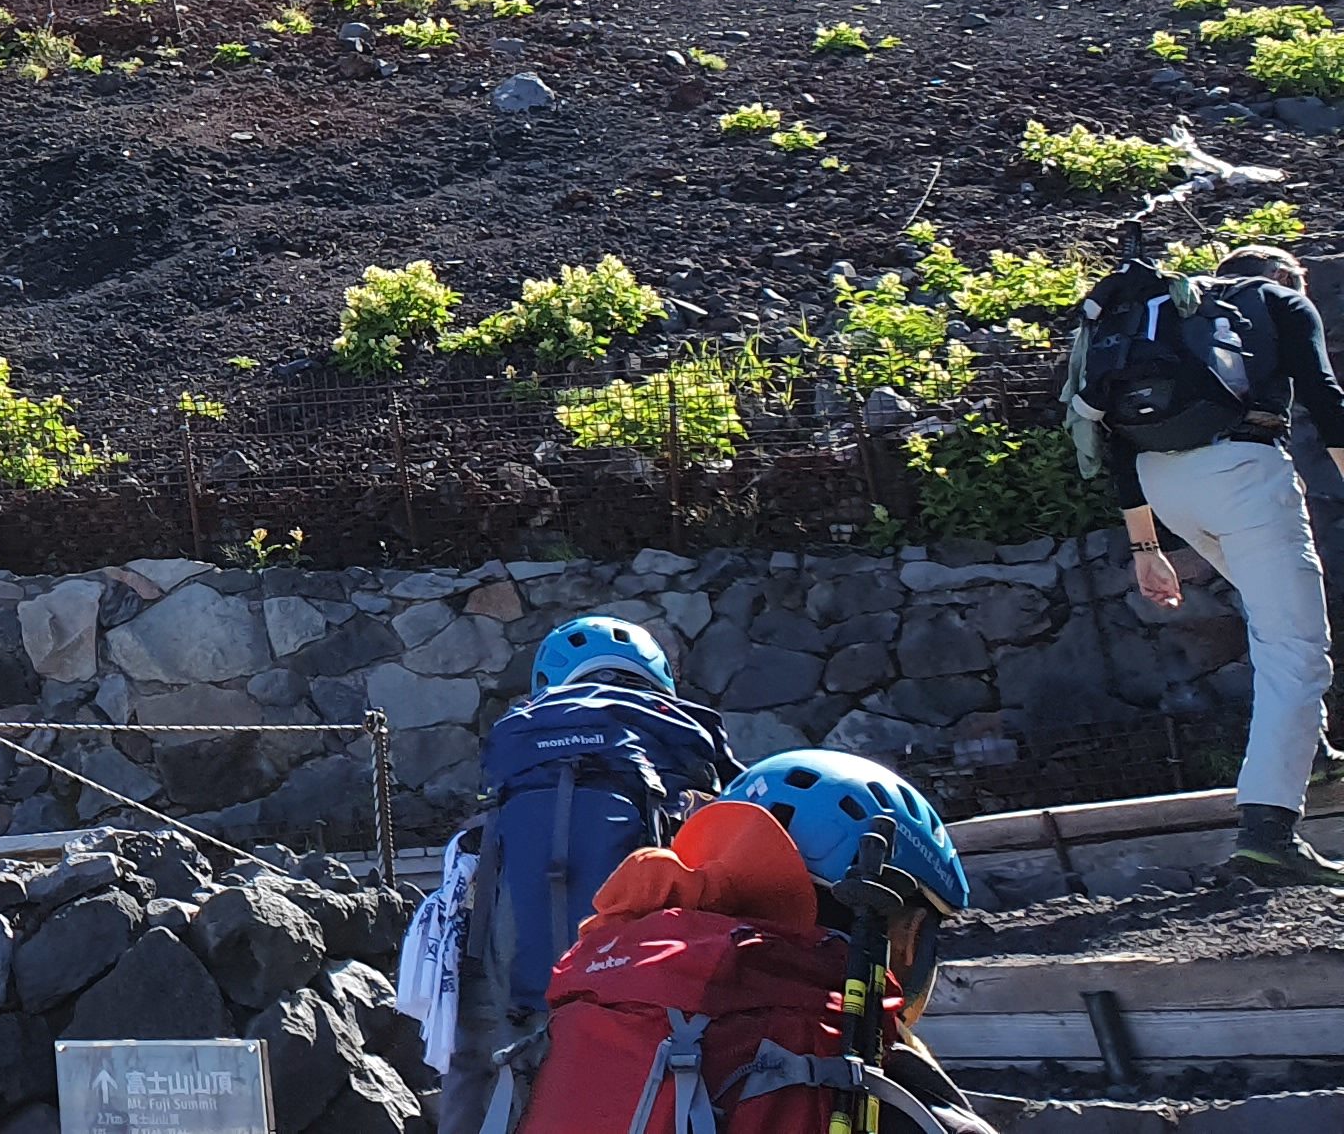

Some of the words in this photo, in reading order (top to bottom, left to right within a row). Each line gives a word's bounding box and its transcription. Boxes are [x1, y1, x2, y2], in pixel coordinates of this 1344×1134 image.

[585, 955, 631, 973] deuter
[125, 1071, 233, 1096] 富士山山頂
[127, 1098, 146, 1110] Mt.
[149, 1098, 170, 1113] Fuji
[175, 1098, 218, 1111] Summit
